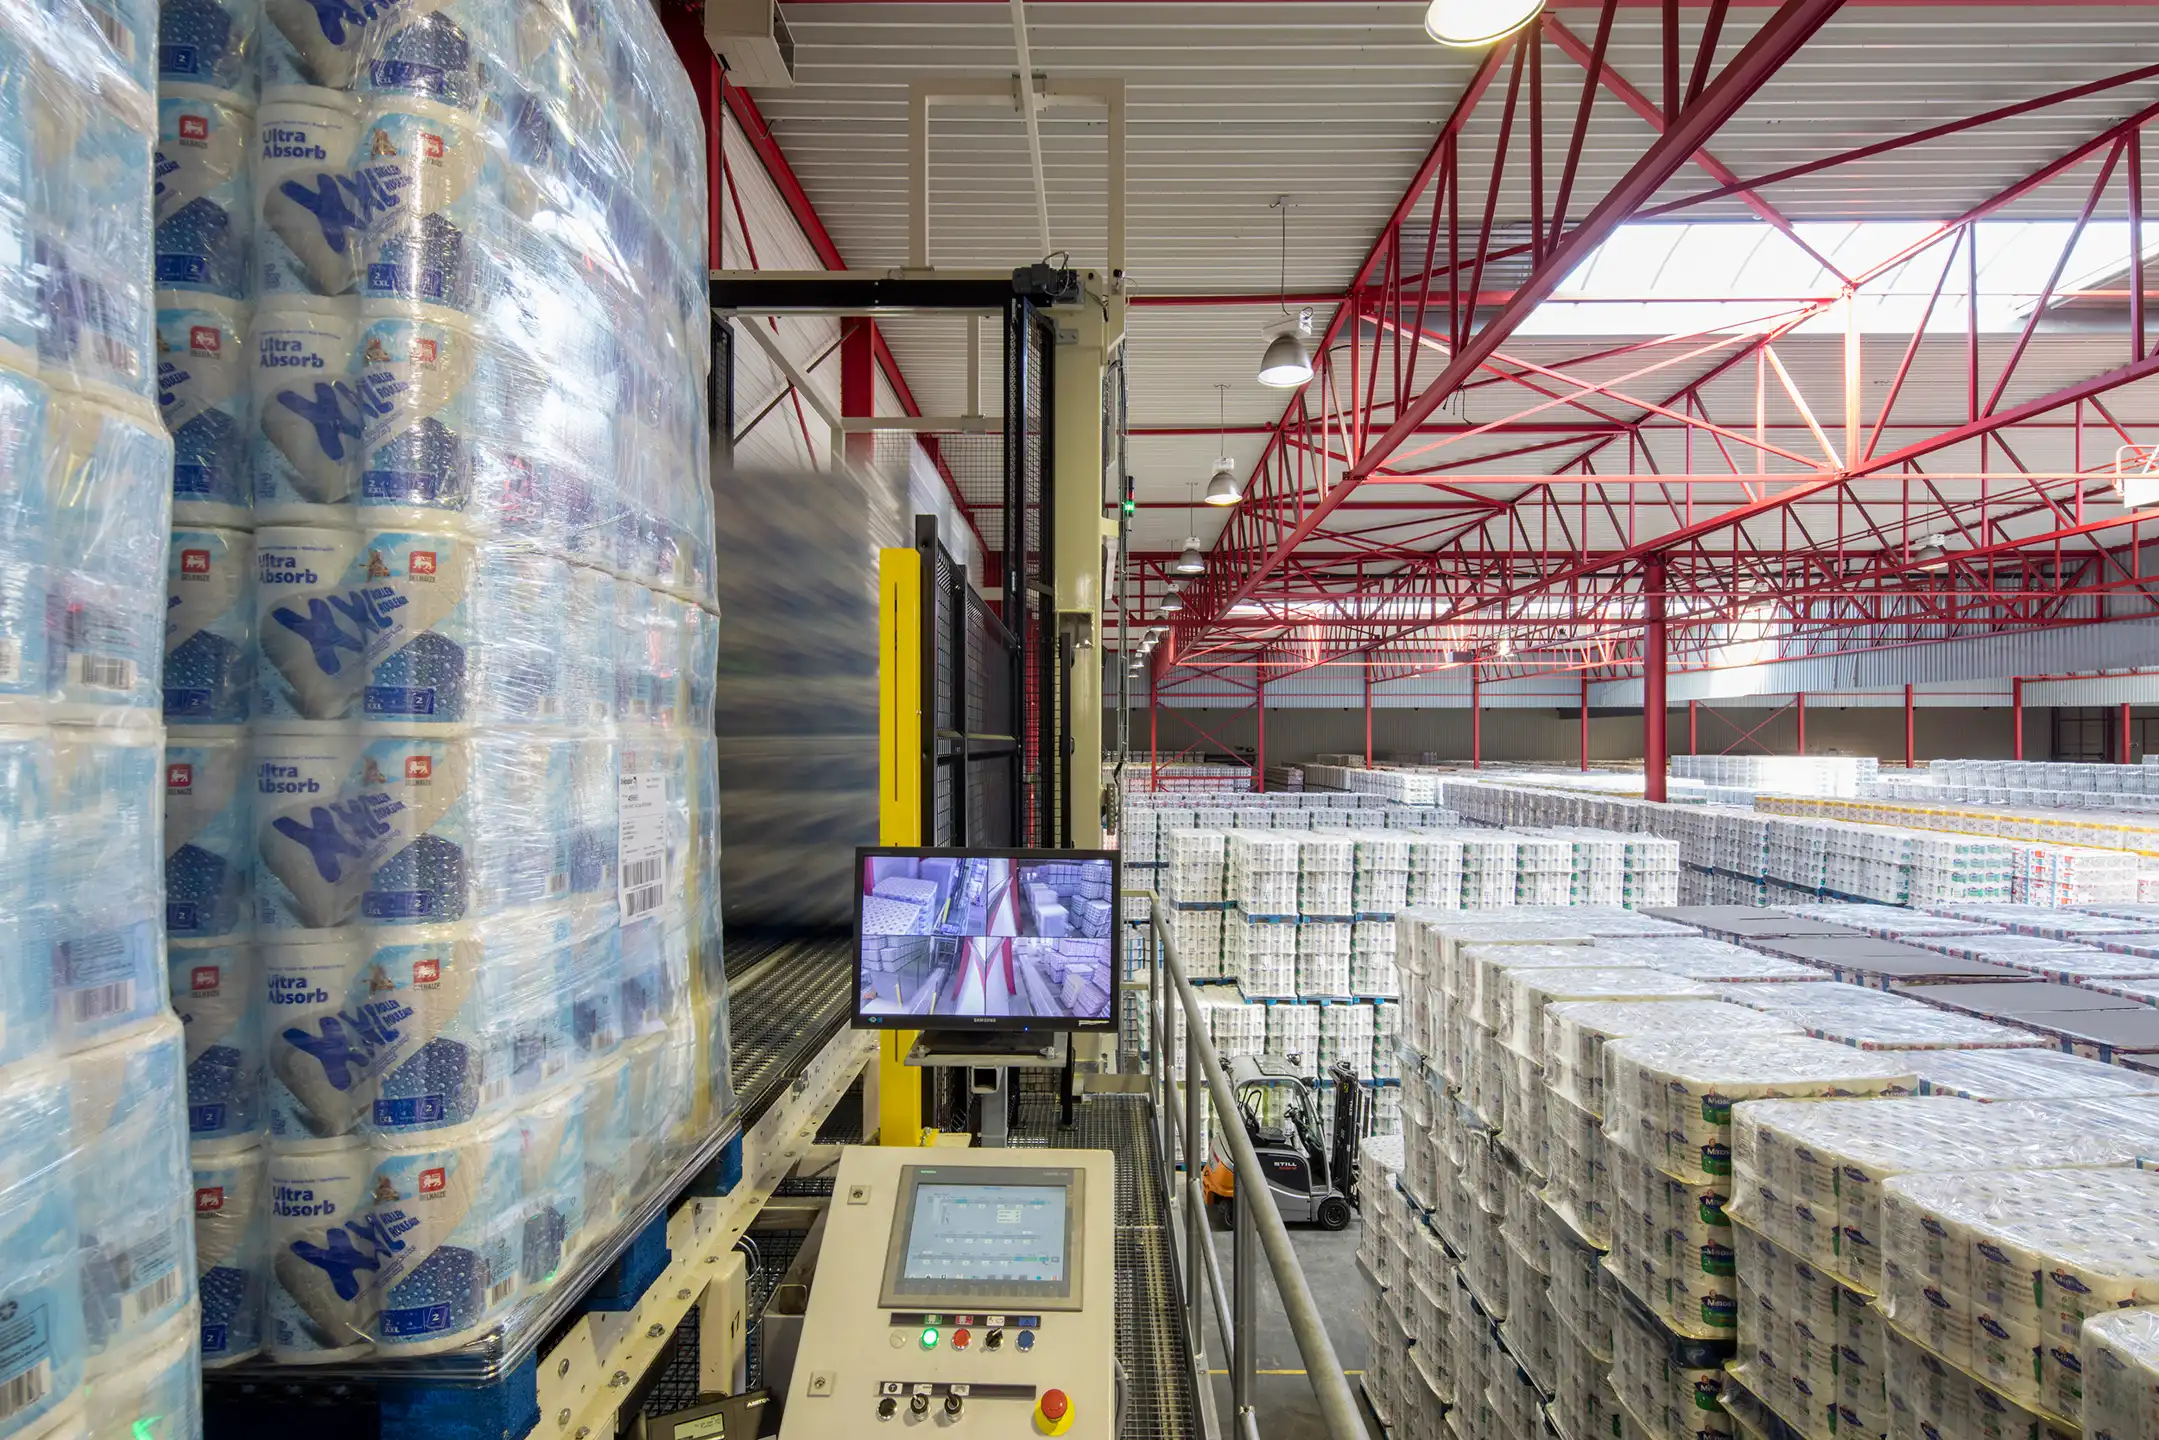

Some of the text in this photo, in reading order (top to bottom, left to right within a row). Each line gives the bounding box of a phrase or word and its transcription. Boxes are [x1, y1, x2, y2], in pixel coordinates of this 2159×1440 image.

[262, 128, 306, 143] Ultra
[262, 144, 327, 160] Absorb
[280, 168, 400, 254] XXL
[260, 337, 303, 352] Ultra
[260, 353, 325, 368] Absorb
[276, 376, 394, 461] XXL
[258, 553, 296, 568] Ultra
[258, 569, 318, 584] Absorb
[409, 574, 436, 583] DELHAIZE
[371, 586, 396, 601] ROLLEN
[377, 595, 410, 614] ROULEAUX
[272, 589, 394, 676] XXL
[191, 698, 199, 706] 2
[367, 702, 383, 710] XXL
[415, 696, 424, 705] 2
[179, 912, 186, 920] 2
[268, 973, 307, 989] Ultra
[268, 988, 329, 1005] Absorb
[375, 1000, 400, 1014] ROLLEN
[382, 1006, 414, 1026] ROULEAUX
[282, 1003, 401, 1092] XXL
[425, 1104, 433, 1112] 2
[206, 1113, 213, 1121] 2
[272, 1186, 314, 1201] Ultra
[419, 1191, 446, 1201] DELHAIZE
[272, 1200, 336, 1217] Absorb
[379, 1210, 406, 1225] ROLLEN
[388, 1217, 421, 1238] ROULEAUX
[290, 1212, 406, 1301] XXL
[431, 1313, 440, 1322] 2
[384, 1326, 400, 1334] XXL
[206, 1334, 214, 1342] 2
